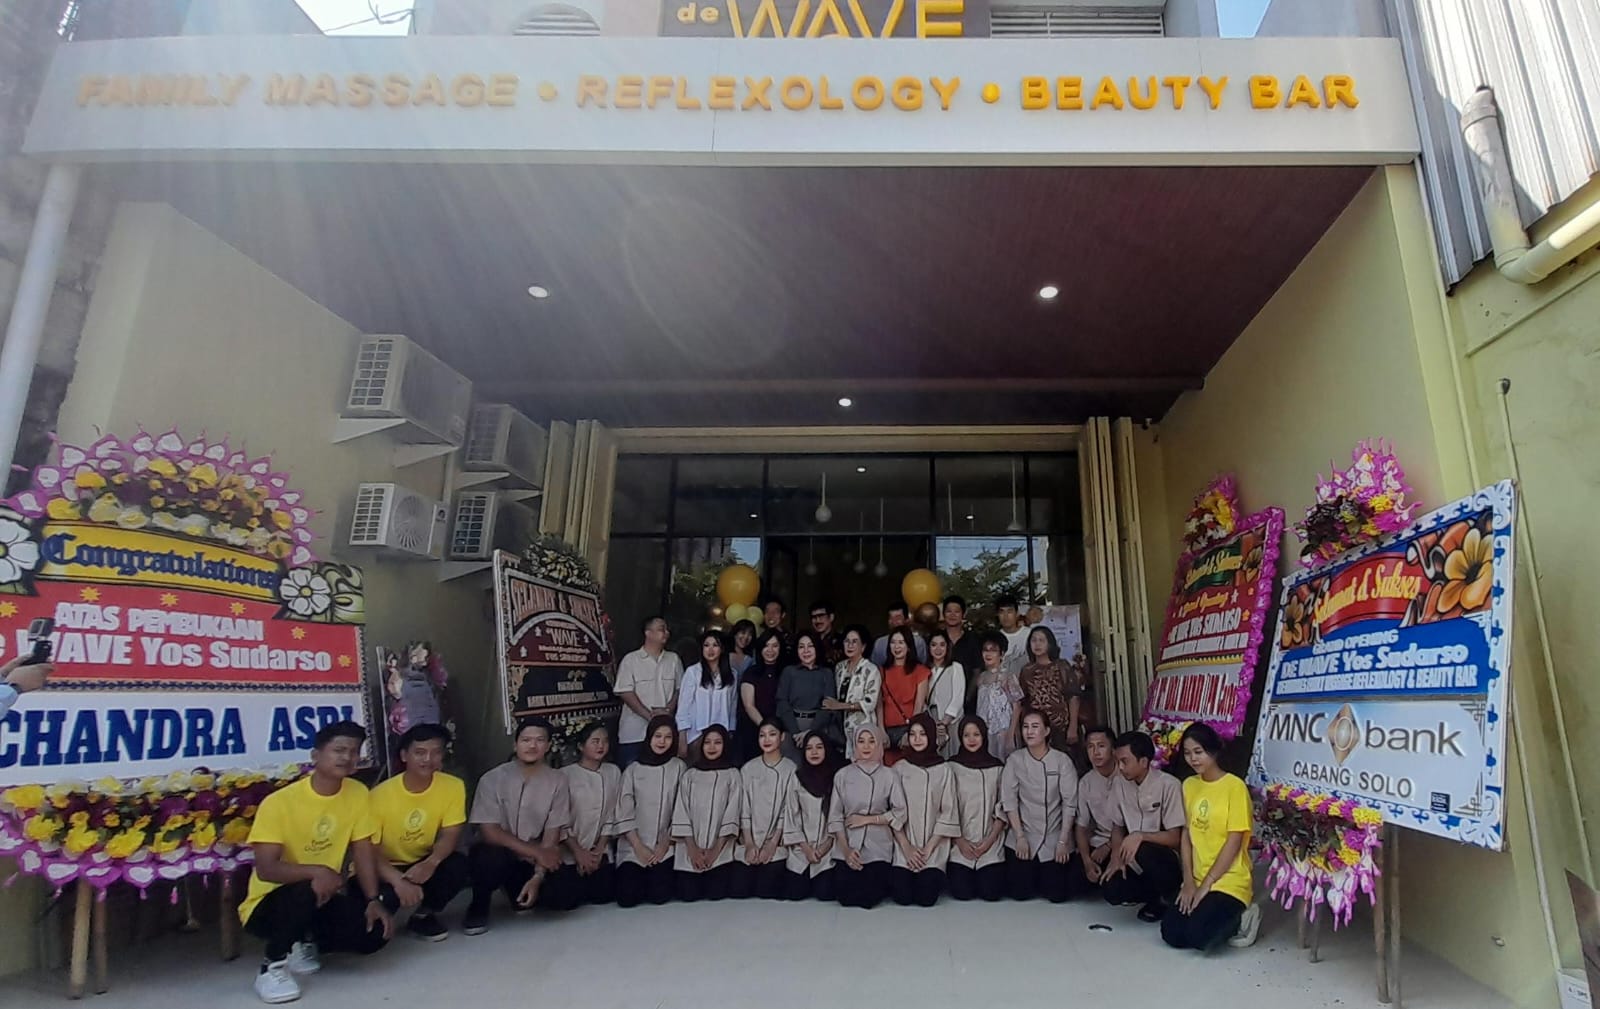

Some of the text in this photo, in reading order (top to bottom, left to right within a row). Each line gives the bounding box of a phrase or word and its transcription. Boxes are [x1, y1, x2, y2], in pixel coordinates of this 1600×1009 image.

[676, 2, 720, 24] de
[78, 72, 1360, 111] FAMILY MASSAGE REFLEXOLOGY BEAUTY BAR
[40, 532, 282, 590] Congratulations
[1371, 561, 1422, 599] Sukses
[55, 602, 265, 641] ATAS PEMBUKAAN
[1344, 629, 1399, 649] OPENING
[140, 636, 203, 667] Yos
[209, 640, 332, 672] Sudarso
[1298, 652, 1340, 677] WAVE
[1341, 650, 1375, 671] Yos
[1375, 643, 1470, 669] Sudarso
[1455, 664, 1478, 688] BAR
[0, 706, 247, 768] CHANDRA
[1269, 712, 1466, 758] MNC bank
[1293, 760, 1415, 799] CABANG SOLO
